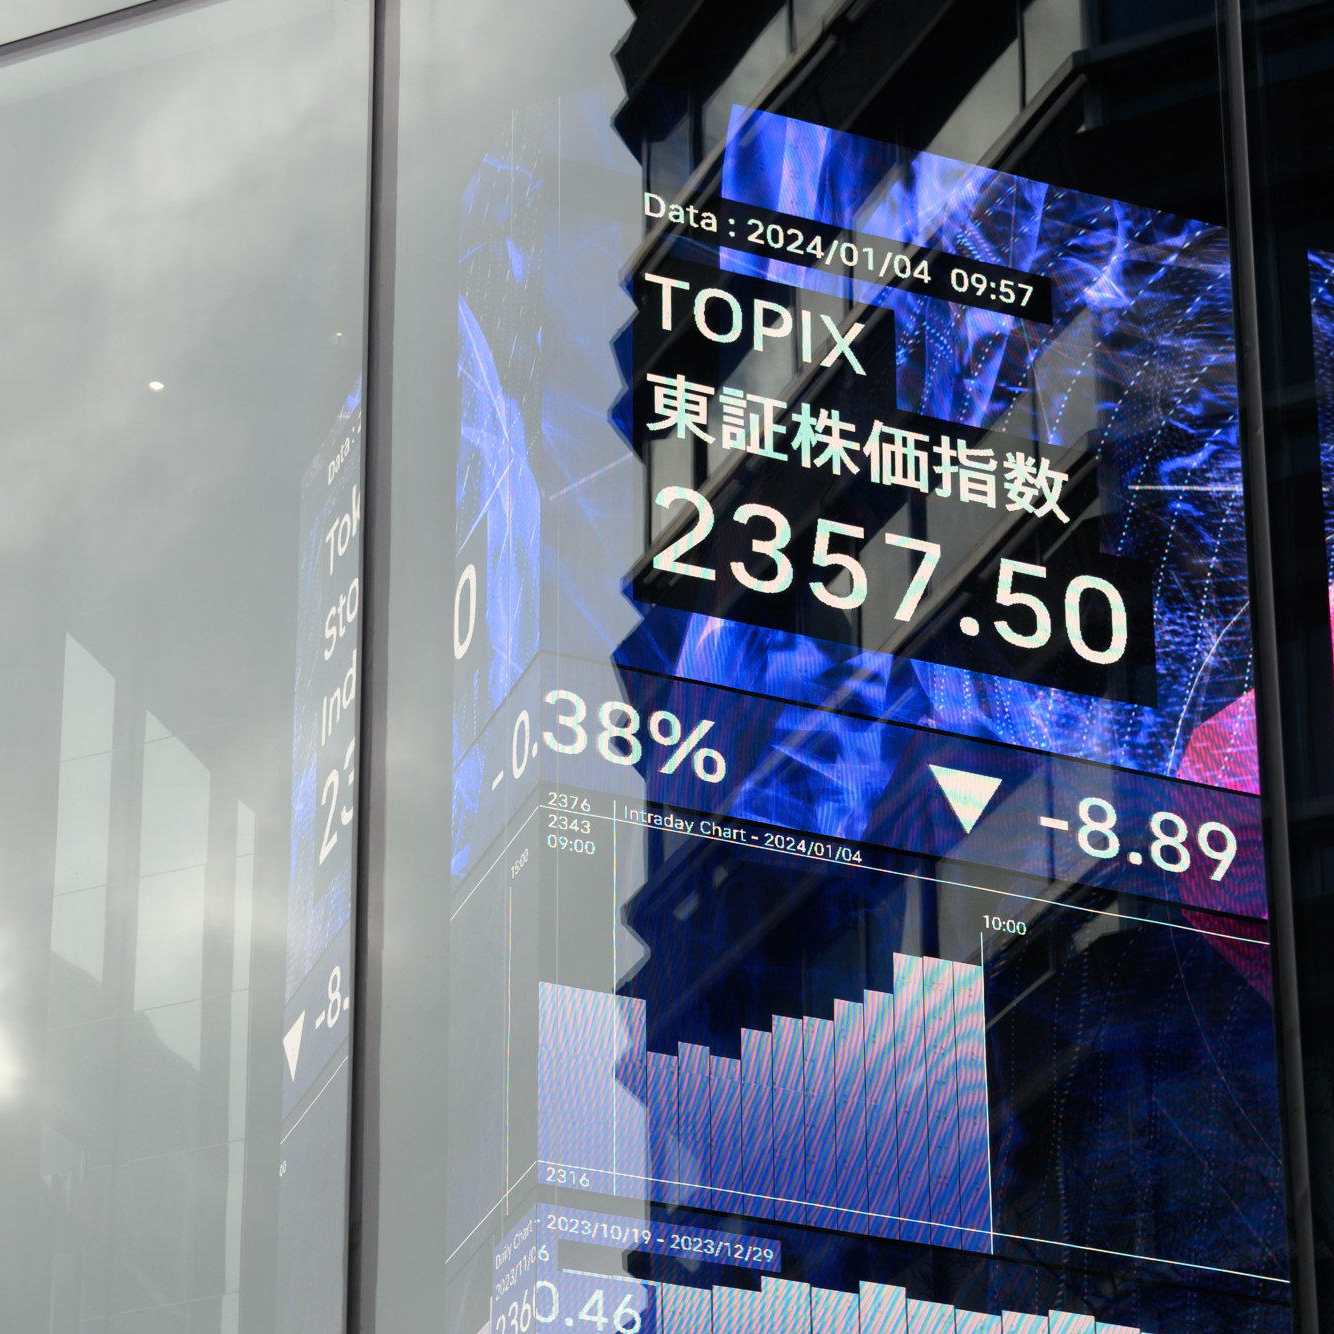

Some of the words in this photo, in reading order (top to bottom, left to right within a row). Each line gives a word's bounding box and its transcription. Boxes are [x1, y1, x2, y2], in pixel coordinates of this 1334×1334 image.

[644, 192, 717, 233] Data
[747, 218, 932, 284] 2024/01/04
[951, 269, 1034, 308] 09:57
[644, 273, 867, 376] TOPIX
[646, 372, 1070, 523] 東証株価指数
[652, 485, 1128, 665] 2357.50
[547, 791, 592, 813] 2376
[547, 814, 591, 835] 2343
[547, 834, 597, 855] 09:00
[624, 805, 695, 834] Intraday
[699, 820, 748, 842] Chart
[764, 832, 863, 863] 2024/01/04
[1038, 797, 1238, 882] -8.89
[982, 914, 1027, 936] 10:00
[546, 1166, 590, 1188] 2316
[495, 1244, 513, 1270] Daily
[513, 1219, 534, 1250] Chart
[546, 1214, 652, 1245] 2023/10/19
[669, 1234, 774, 1263] 2023/12/29
